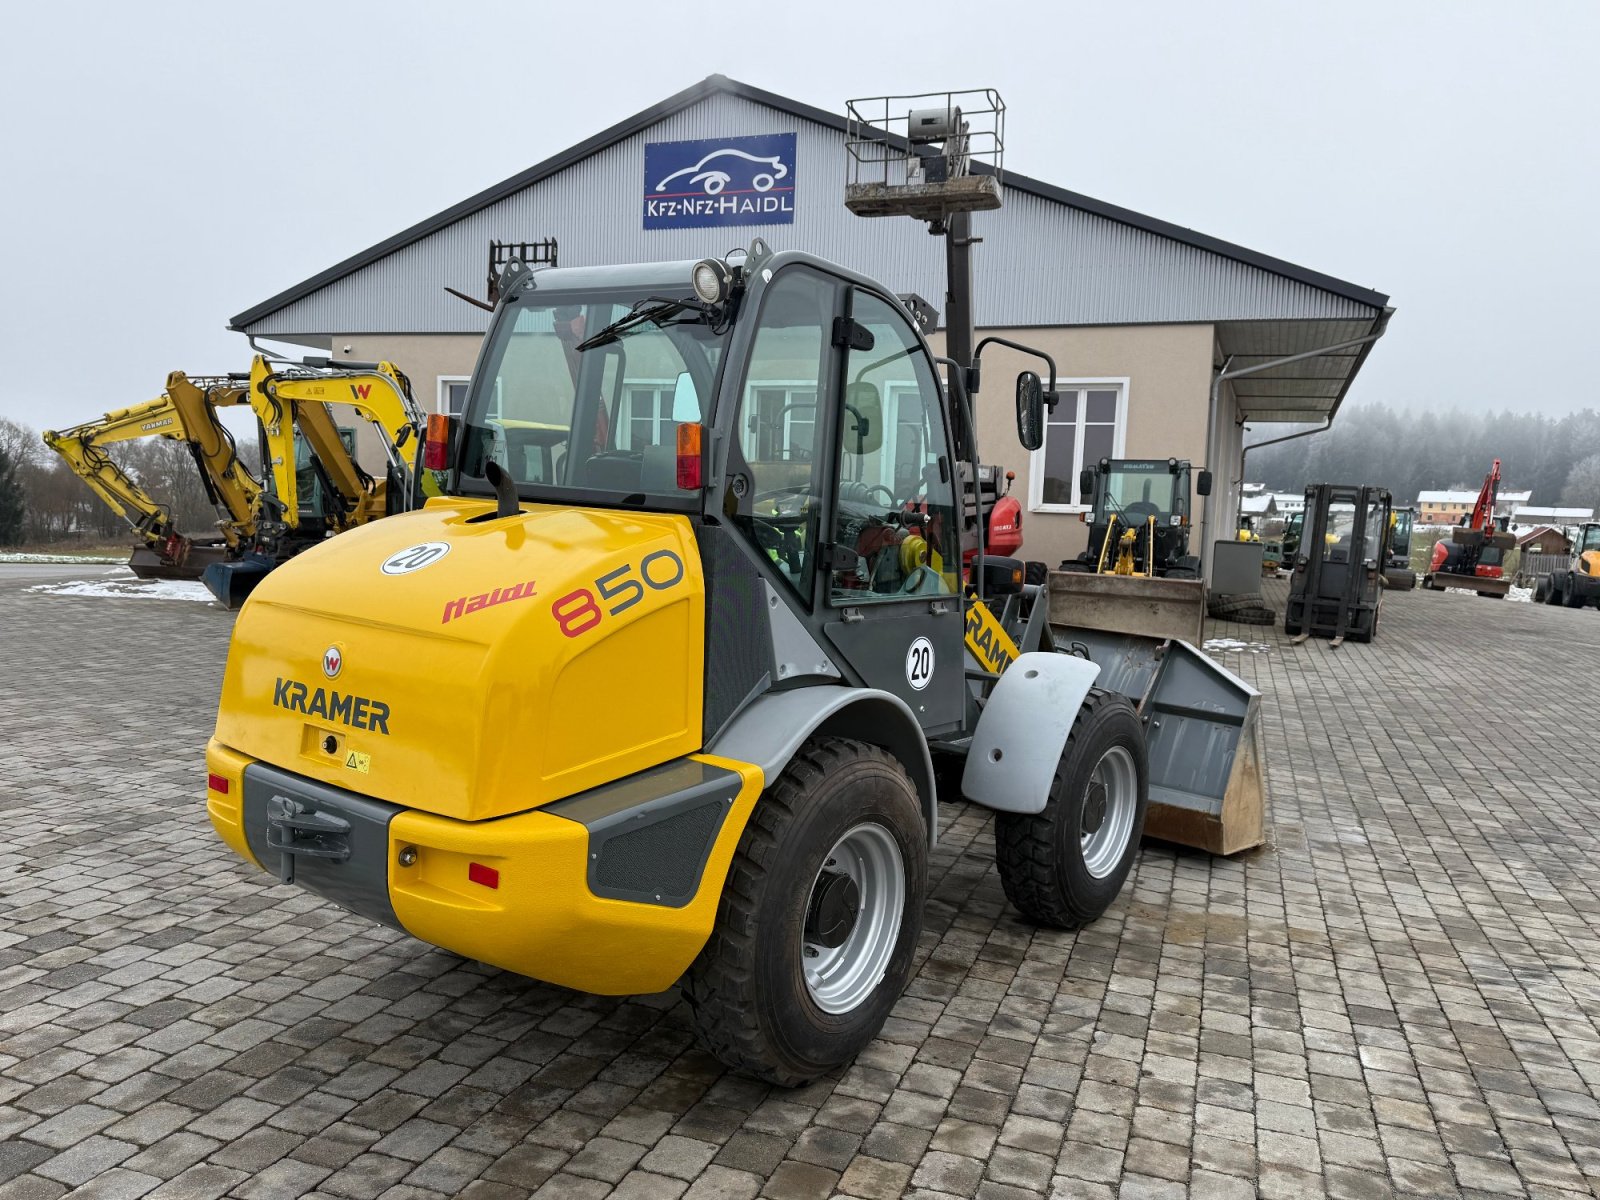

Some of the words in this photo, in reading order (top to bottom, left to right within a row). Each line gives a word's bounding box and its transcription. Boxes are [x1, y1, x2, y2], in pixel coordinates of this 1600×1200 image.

[141, 417, 173, 430] YANMAR
[388, 546, 442, 569] 20
[552, 549, 684, 638] 850
[911, 647, 930, 680] 20
[273, 677, 390, 735] KRAMER
